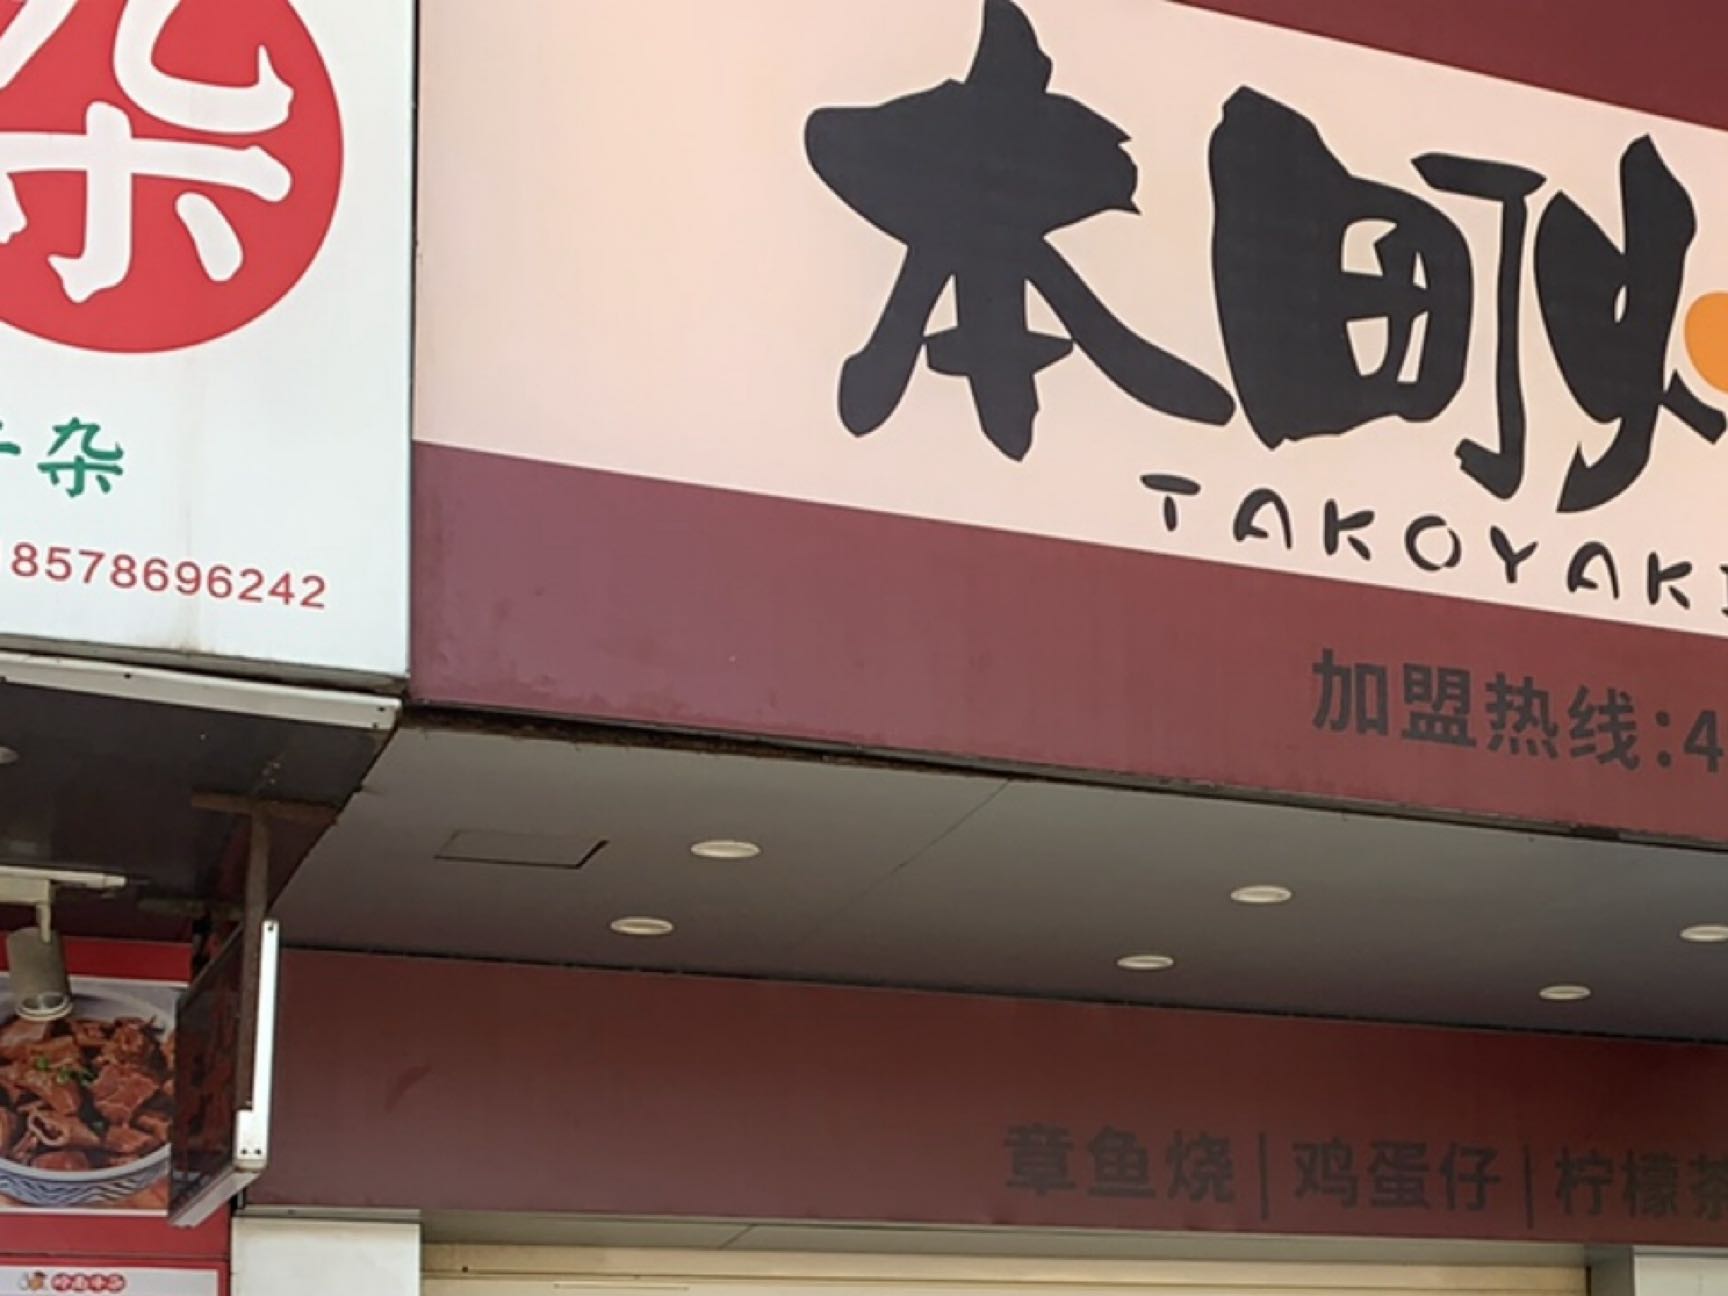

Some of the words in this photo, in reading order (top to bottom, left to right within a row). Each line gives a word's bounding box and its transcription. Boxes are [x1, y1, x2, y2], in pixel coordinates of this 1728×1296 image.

[0, 417, 126, 499] 杂
[10, 541, 328, 609] 8578696242
[1004, 1122, 1234, 1204] 章鱼烧
[1292, 1138, 1502, 1212] 鸡蛋仔
